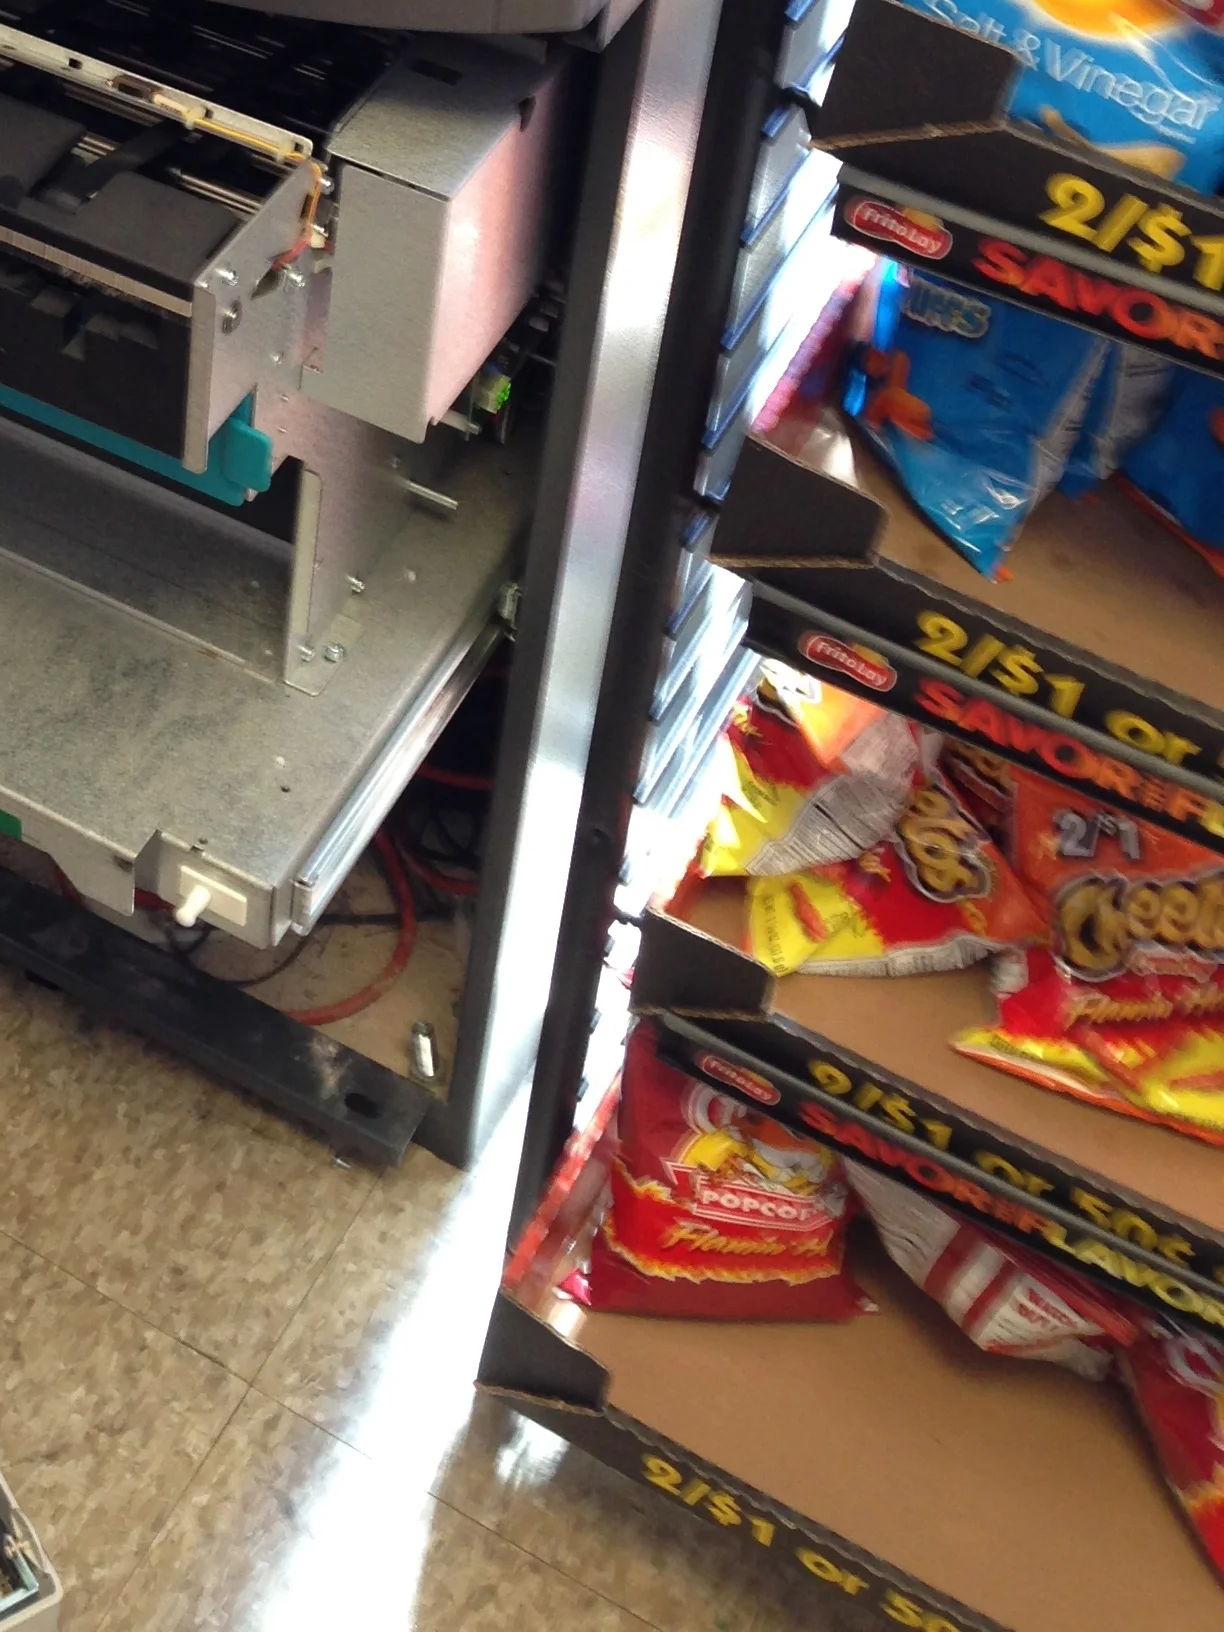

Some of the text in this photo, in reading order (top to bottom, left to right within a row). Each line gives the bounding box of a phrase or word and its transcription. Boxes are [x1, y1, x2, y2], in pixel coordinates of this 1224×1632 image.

[1013, 29, 1042, 72] &
[1043, 38, 1223, 144] Vinegar
[972, 236, 1224, 360] SAVOR
[913, 610, 1085, 718] 2/$1
[914, 676, 1141, 800] SAVOR
[798, 1100, 994, 1213] SAVOR
[641, 1453, 775, 1547] 2/$1
